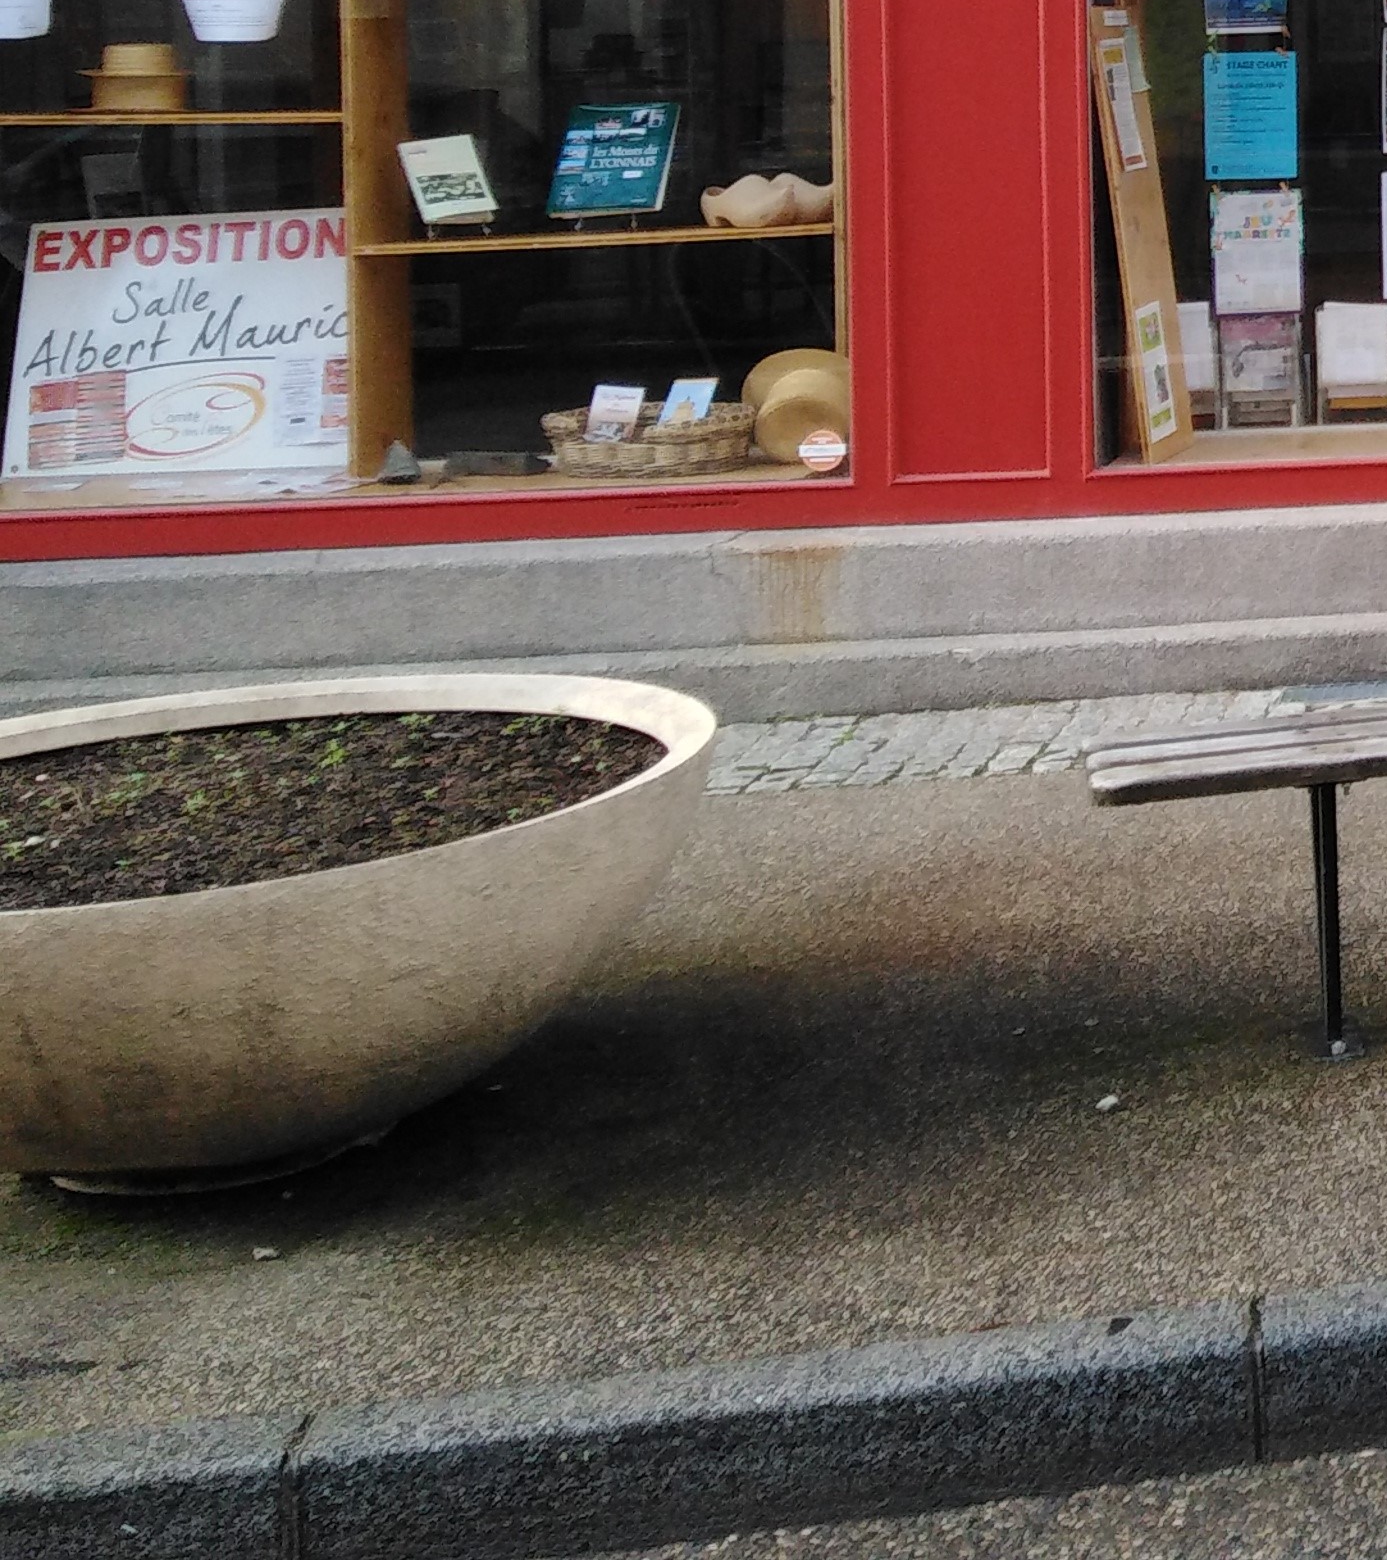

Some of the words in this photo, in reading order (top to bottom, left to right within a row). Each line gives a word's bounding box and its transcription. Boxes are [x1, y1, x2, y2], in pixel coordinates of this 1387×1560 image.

[32, 217, 346, 273] EXPOSITION
[112, 277, 210, 324] Salle
[22, 319, 172, 378] Albert
